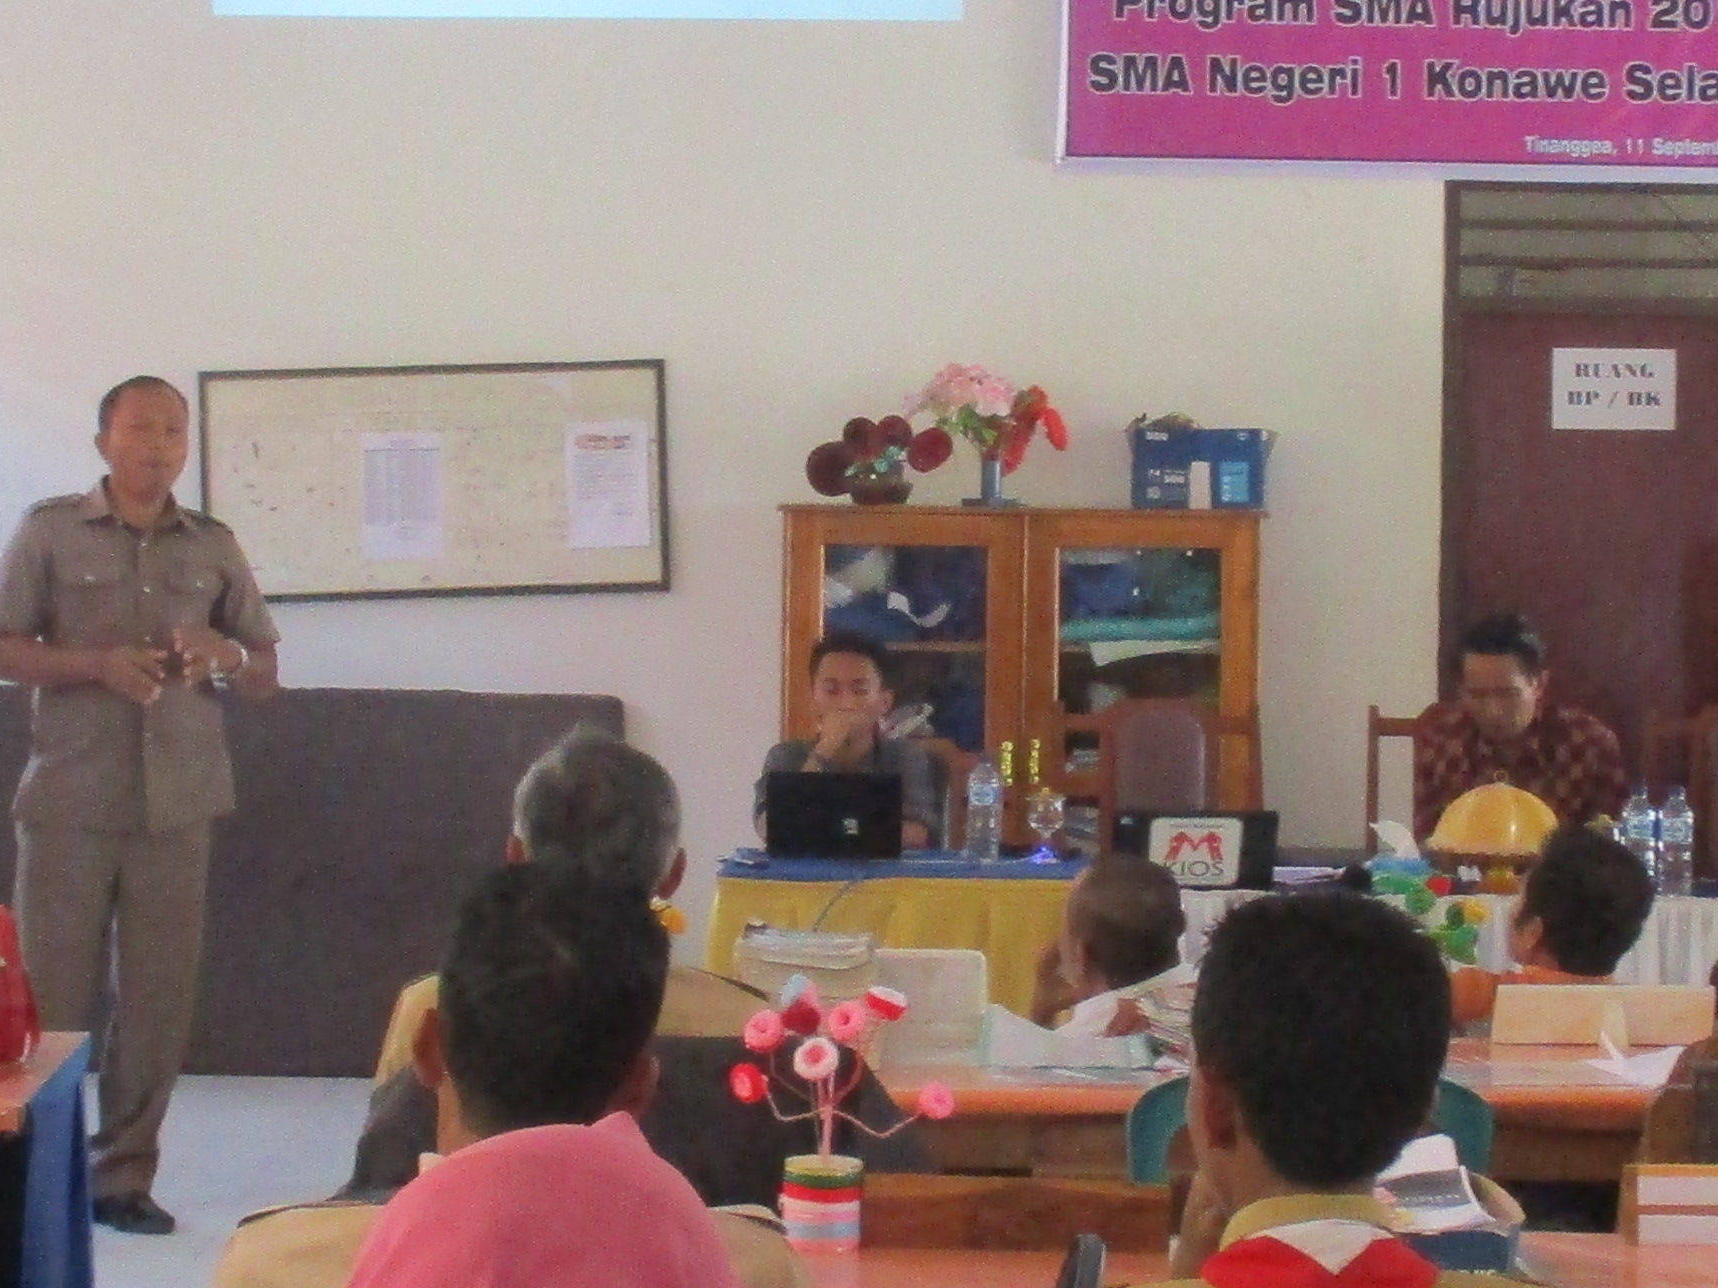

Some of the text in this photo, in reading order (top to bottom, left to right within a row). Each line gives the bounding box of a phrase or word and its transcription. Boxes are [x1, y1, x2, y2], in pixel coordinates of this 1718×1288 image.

[1089, 54, 1192, 95] SMA
[1209, 56, 1362, 107] Negeri
[1382, 58, 1402, 100] 1
[1425, 59, 1607, 103] Konawe
[1627, 137, 1644, 154] 11
[1575, 363, 1655, 378] RUANG
